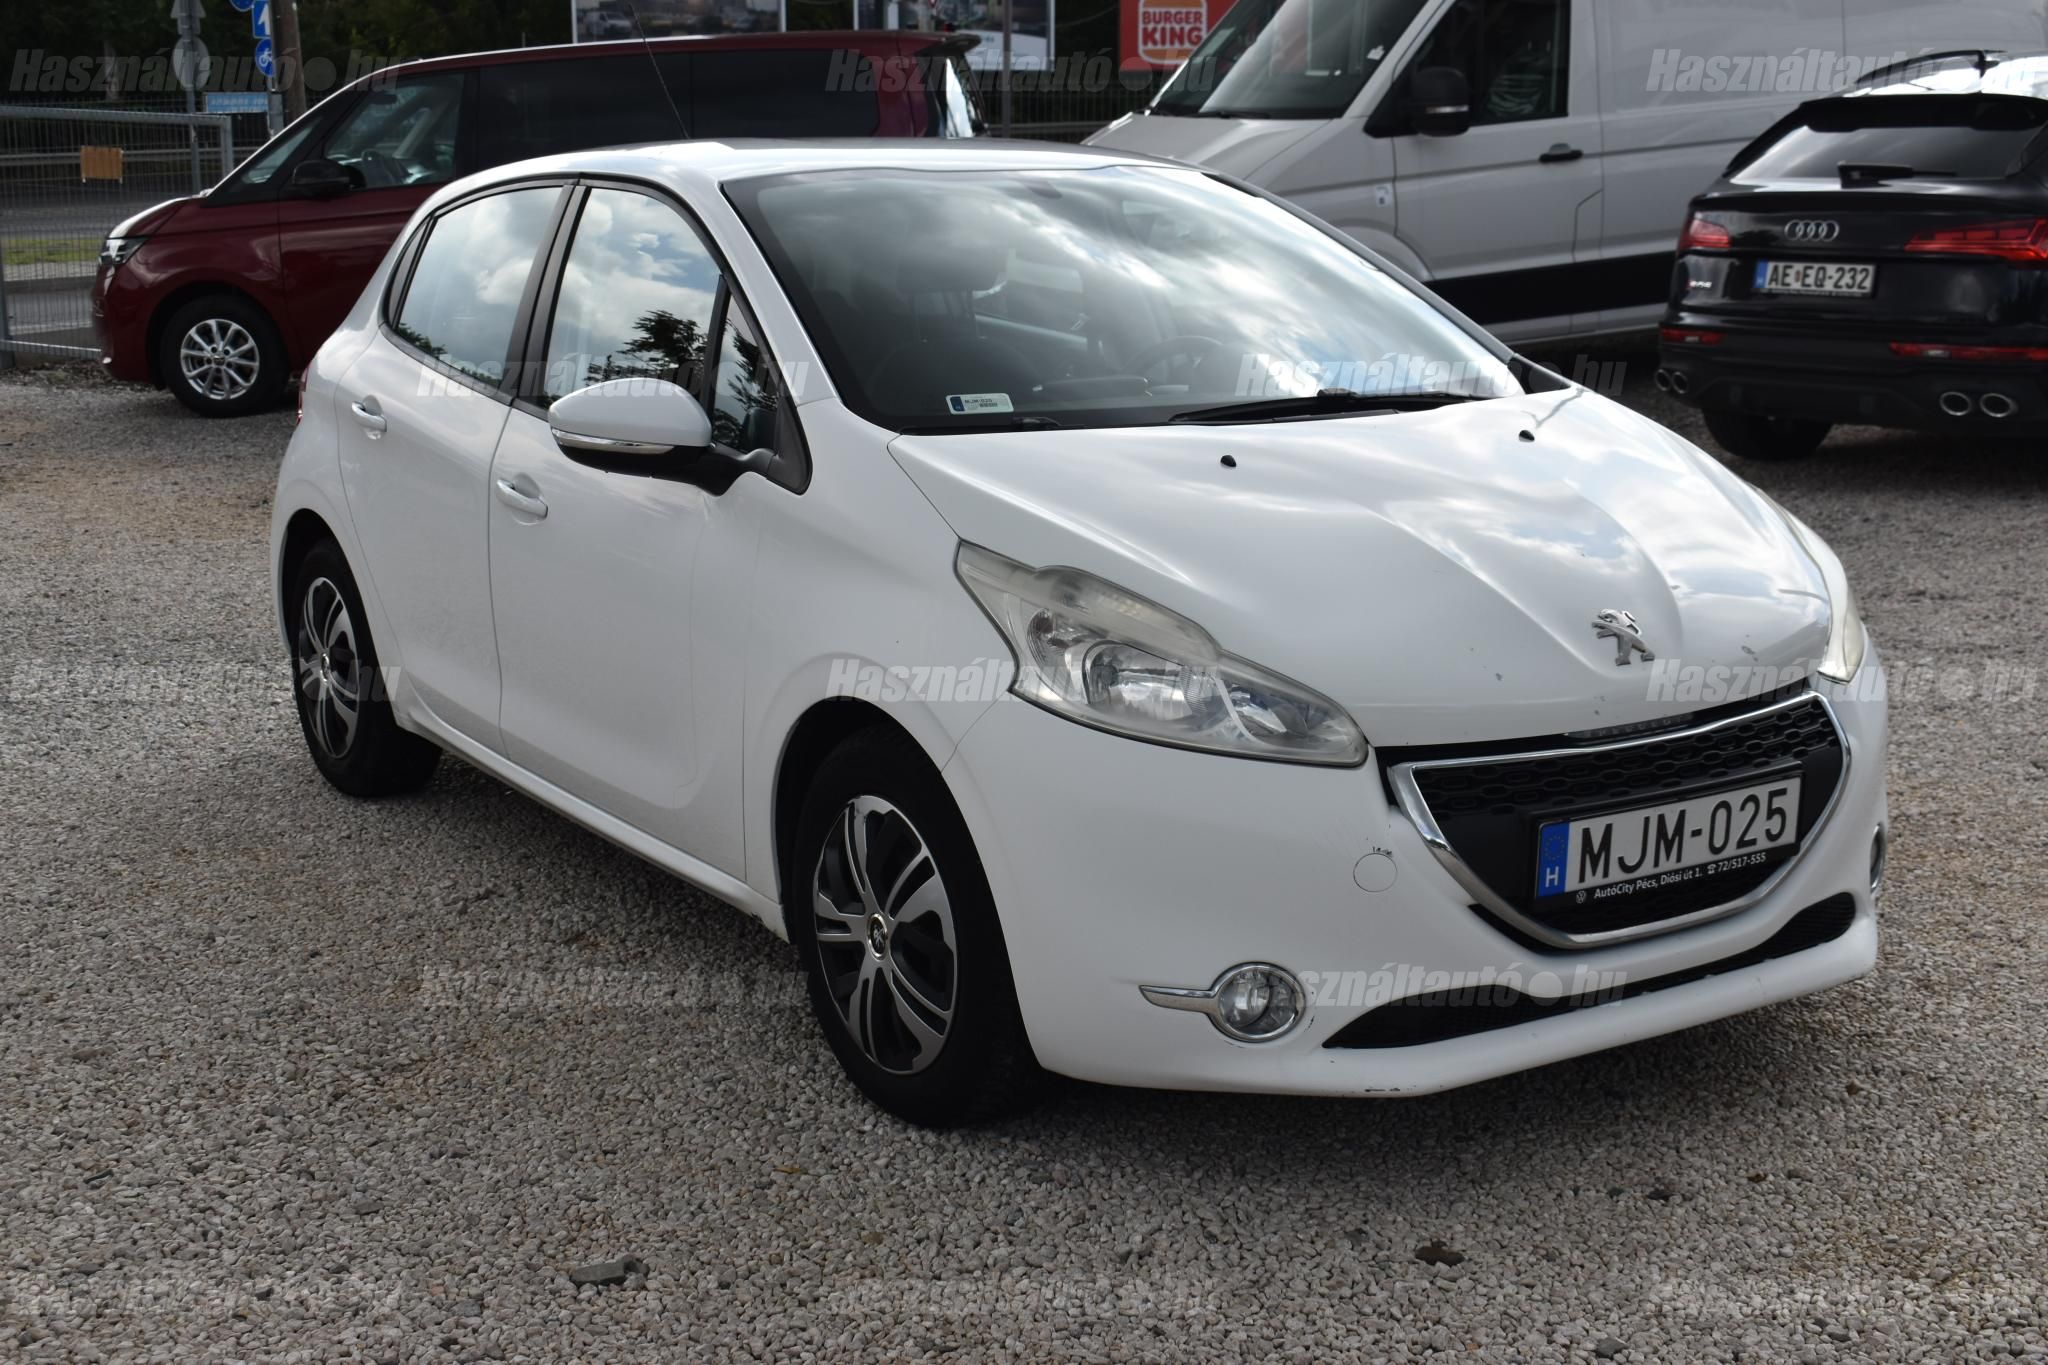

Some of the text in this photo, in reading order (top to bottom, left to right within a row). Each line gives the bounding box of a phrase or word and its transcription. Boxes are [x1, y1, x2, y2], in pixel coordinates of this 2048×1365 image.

[1142, 10, 1203, 25] BURGER
[1142, 26, 1203, 46] KING
[1768, 264, 1794, 287] AE
[1801, 265, 1870, 290] EQ-232
[1578, 787, 1788, 883] MJM-025
[1545, 866, 1560, 888] H
[1594, 880, 1635, 900] AutóCity
[1636, 877, 1659, 890] Pécs,
[1717, 852, 1767, 873] 72/517-555
